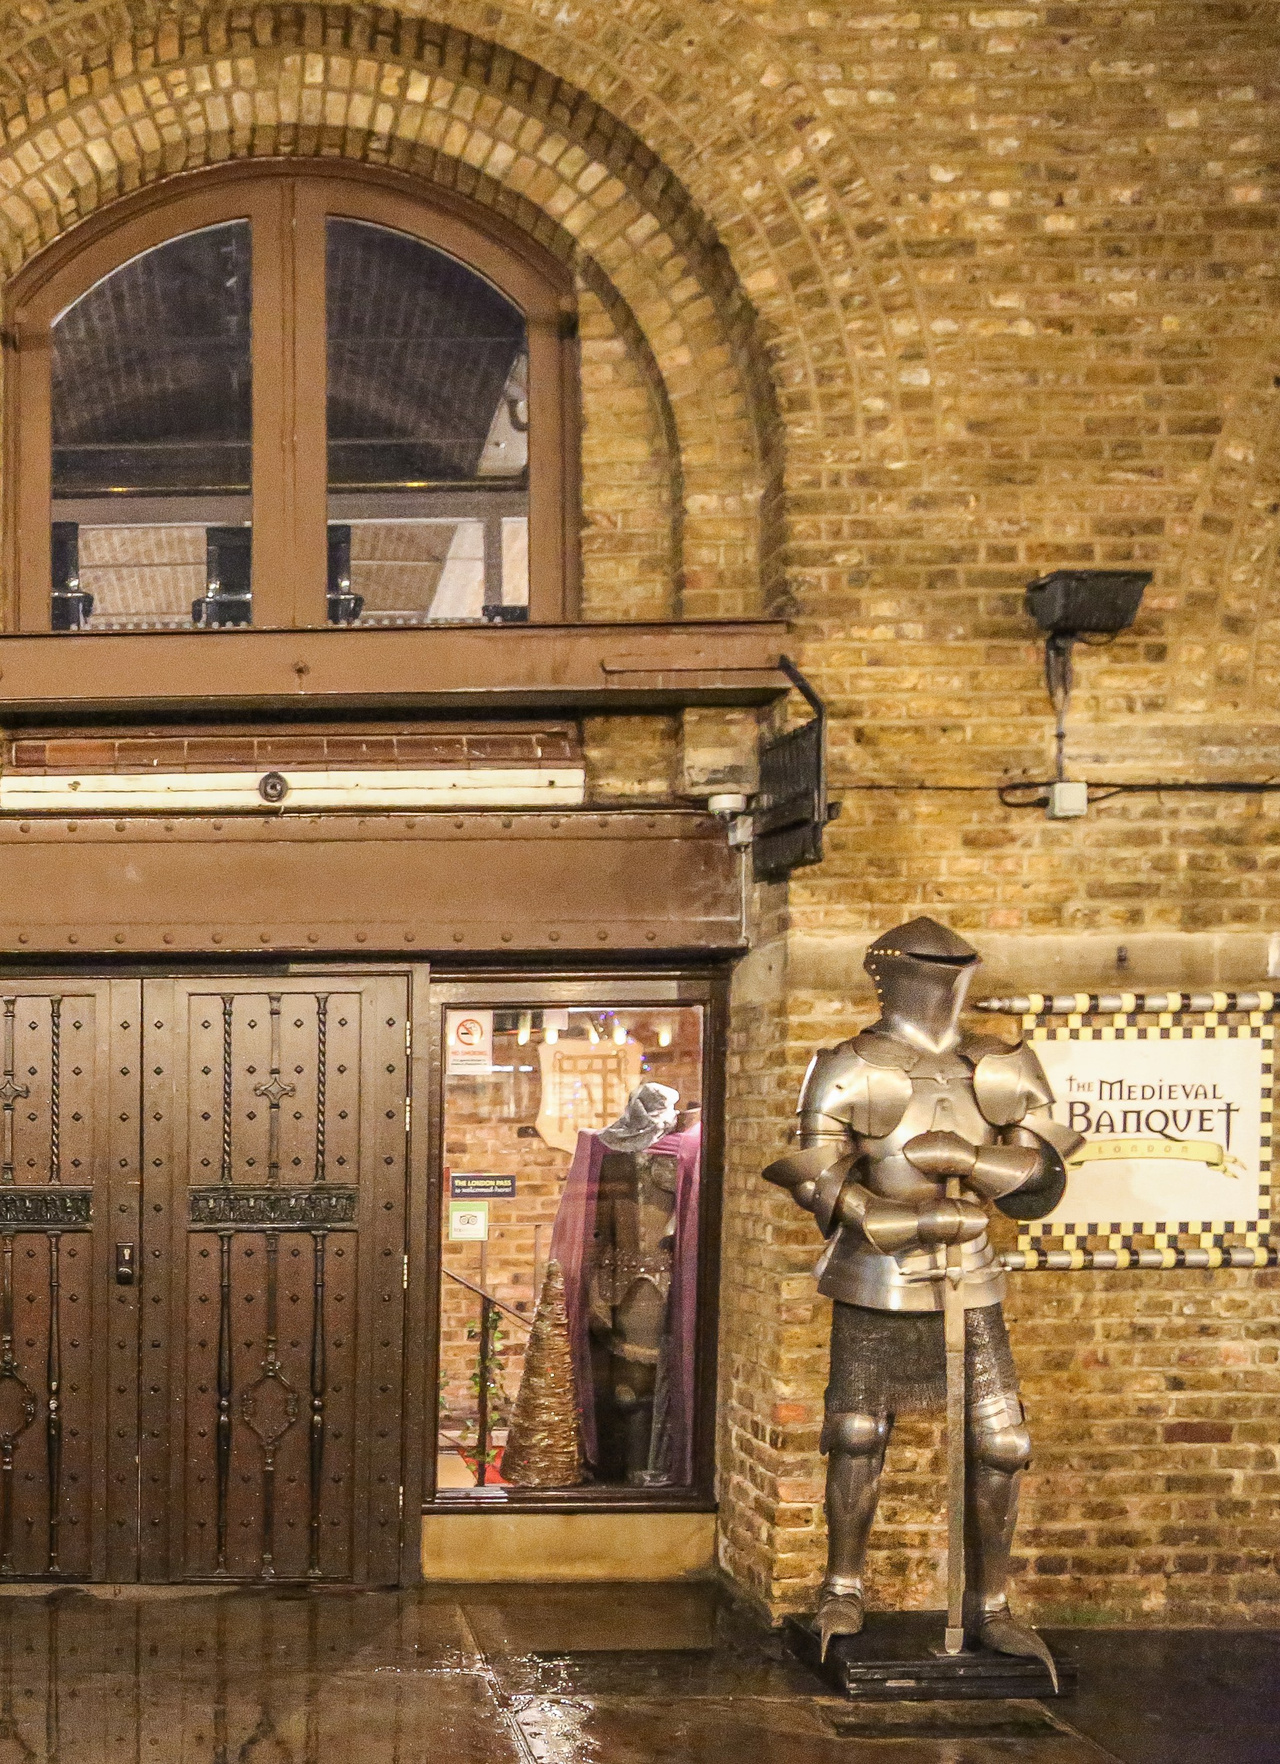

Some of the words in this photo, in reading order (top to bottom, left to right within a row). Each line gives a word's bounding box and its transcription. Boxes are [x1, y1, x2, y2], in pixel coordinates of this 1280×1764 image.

[1066, 1075, 1094, 1093] THE
[1067, 1101, 1240, 1152] BANQUET
[1097, 1145, 1189, 1154] LONDON
[454, 1179, 467, 1187] THE
[467, 1179, 495, 1187] LONDON
[496, 1179, 512, 1187] PASS
